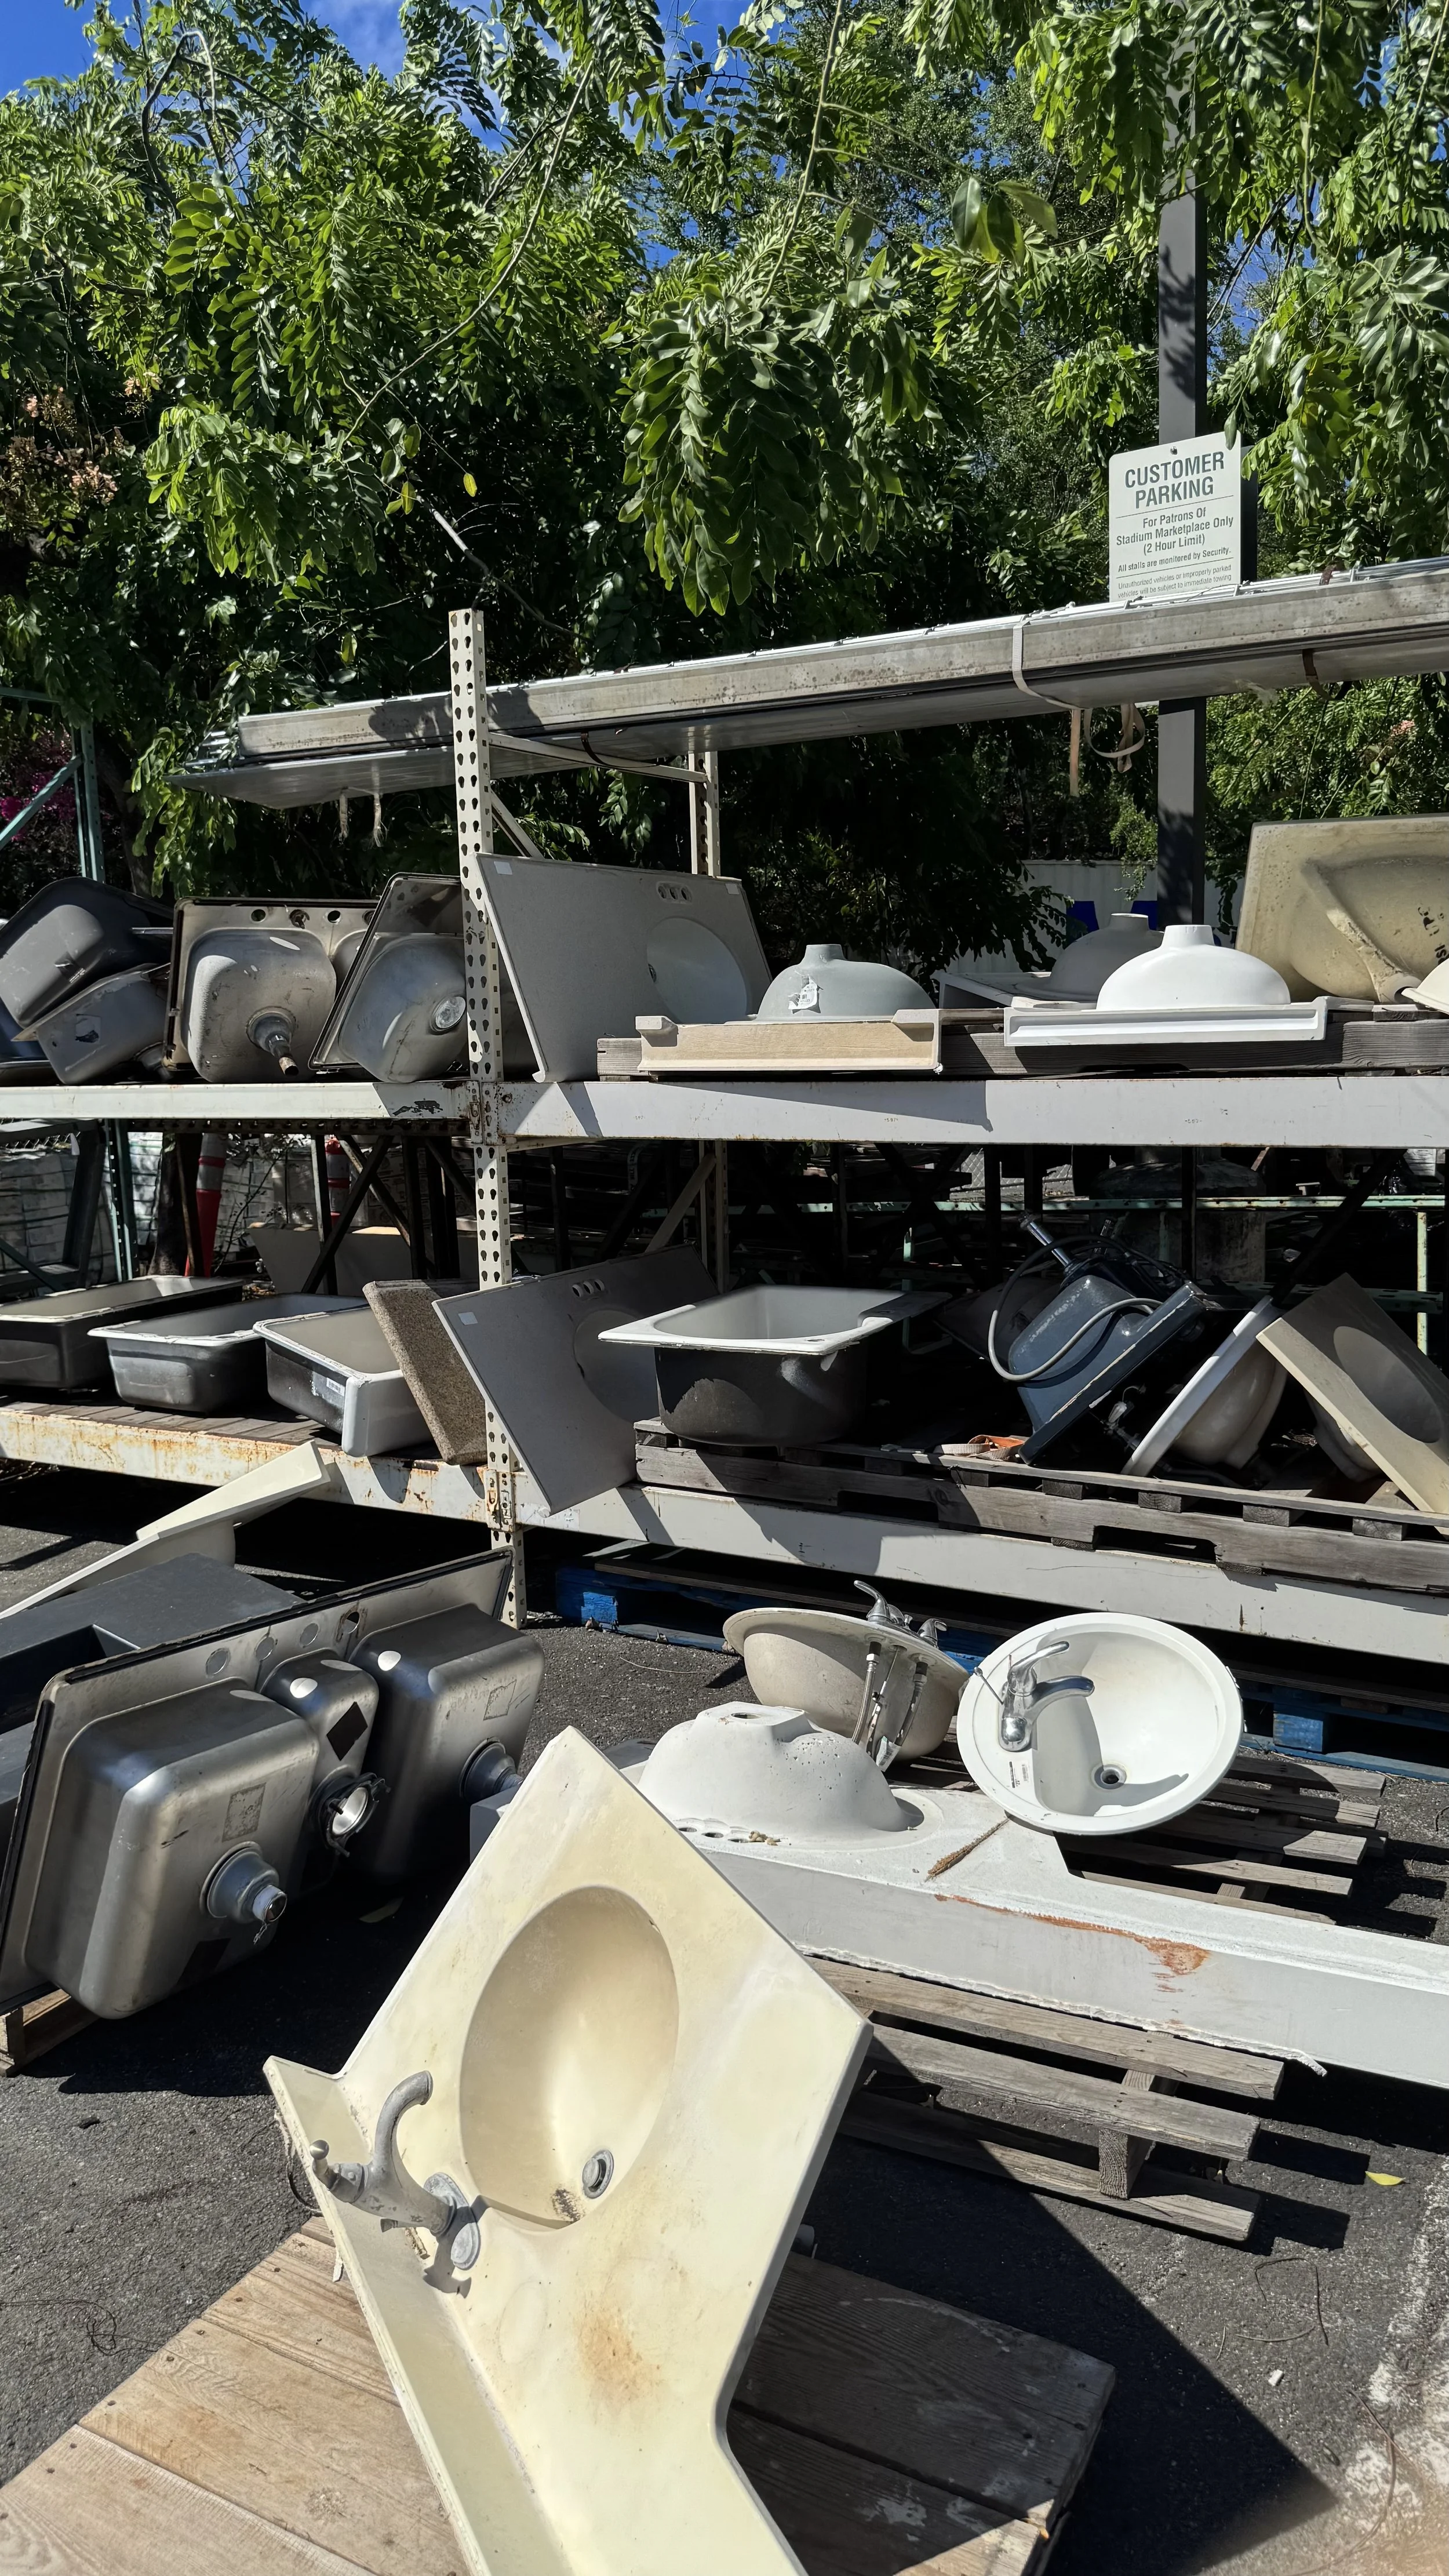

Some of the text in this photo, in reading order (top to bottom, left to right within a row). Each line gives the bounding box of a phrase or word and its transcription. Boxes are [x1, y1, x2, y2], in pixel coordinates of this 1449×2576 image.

[1125, 451, 1224, 487] CUSTOMER
[1136, 476, 1213, 509] PARKING
[1143, 507, 1206, 528] For Patrons Of
[1117, 516, 1233, 545] Stadium Marketplace Only
[1144, 534, 1205, 556] (2 Hour Limit)
[1128, 562, 1145, 570] stalls
[1159, 553, 1191, 565] monitored
[1193, 551, 1200, 560] by
[1203, 547, 1231, 557] Security.
[1119, 578, 1152, 589] Unauthorized
[1183, 567, 1211, 578] improperly
[1213, 565, 1231, 573] parked
